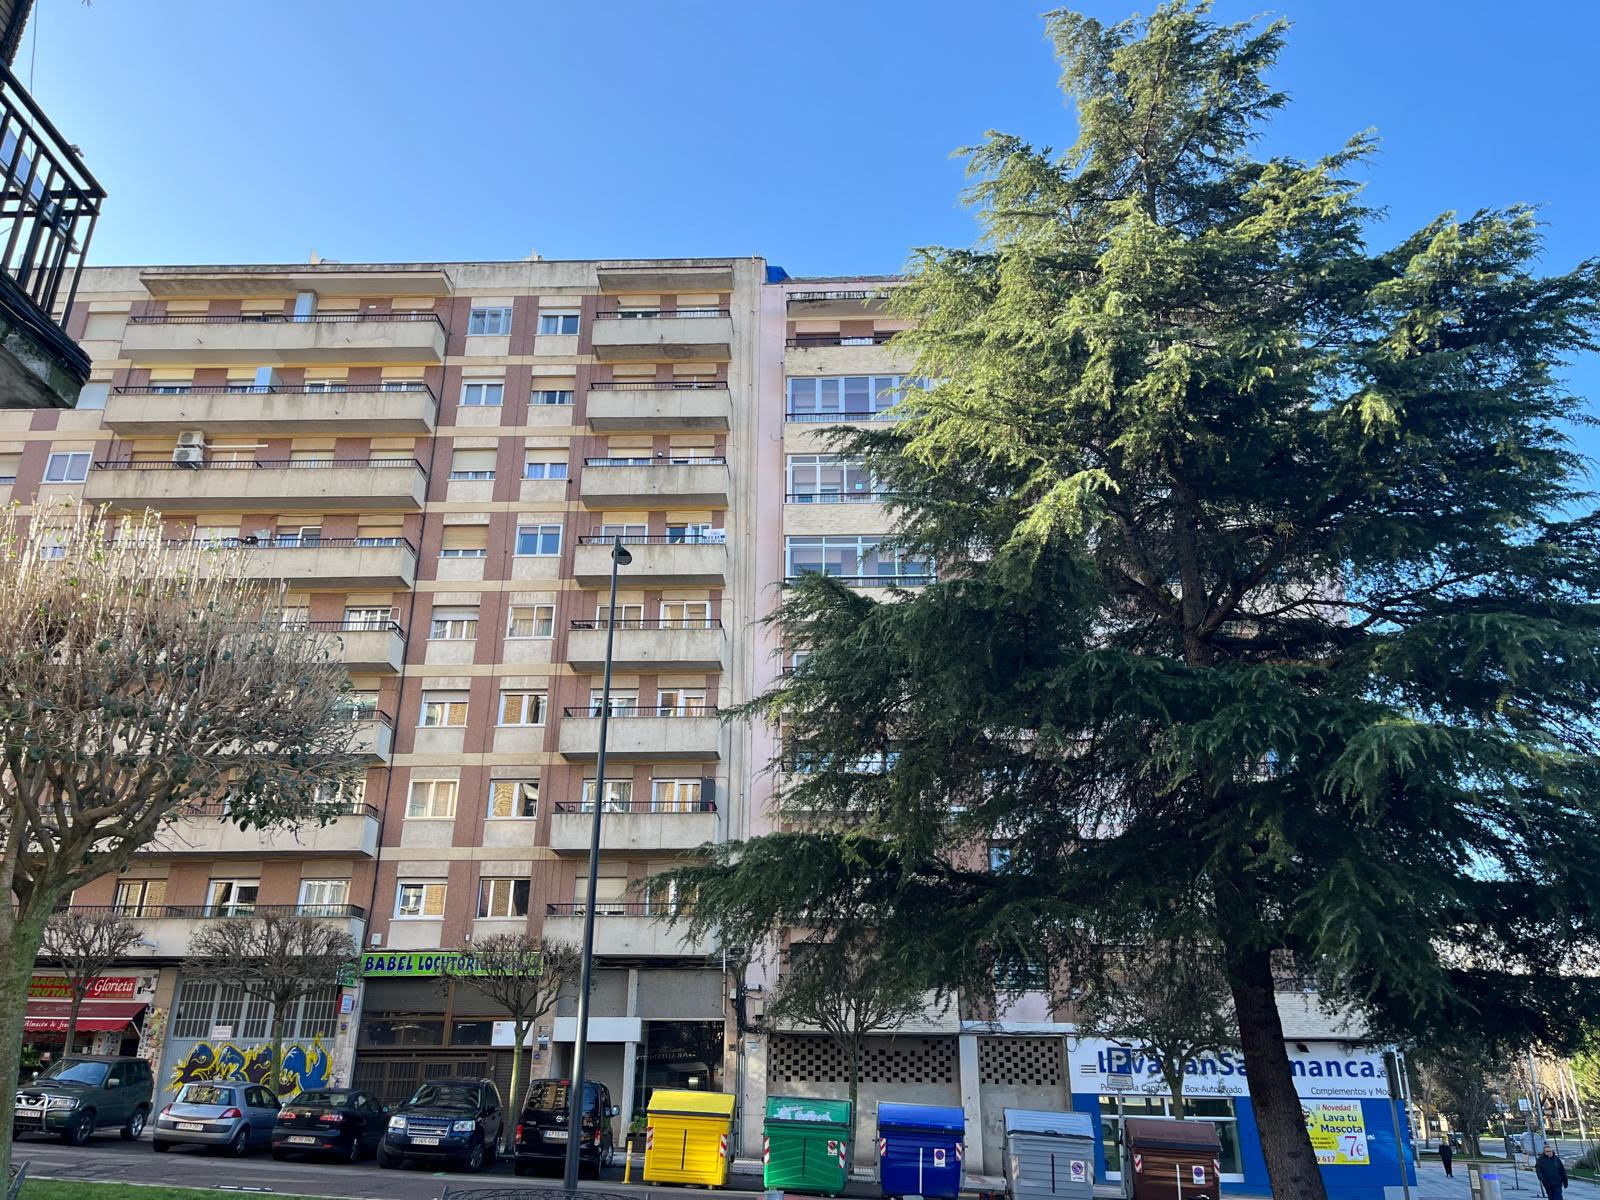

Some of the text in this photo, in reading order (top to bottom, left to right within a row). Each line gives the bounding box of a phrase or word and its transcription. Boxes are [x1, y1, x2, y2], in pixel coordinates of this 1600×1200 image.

[365, 956, 413, 971] BABEL
[94, 979, 133, 996] Glorieta
[1310, 1086, 1367, 1096] Complementos
[1368, 1088, 1373, 1096] y
[1323, 1114, 1357, 1122] Lava tu
[1321, 1125, 1363, 1134] Mascota
